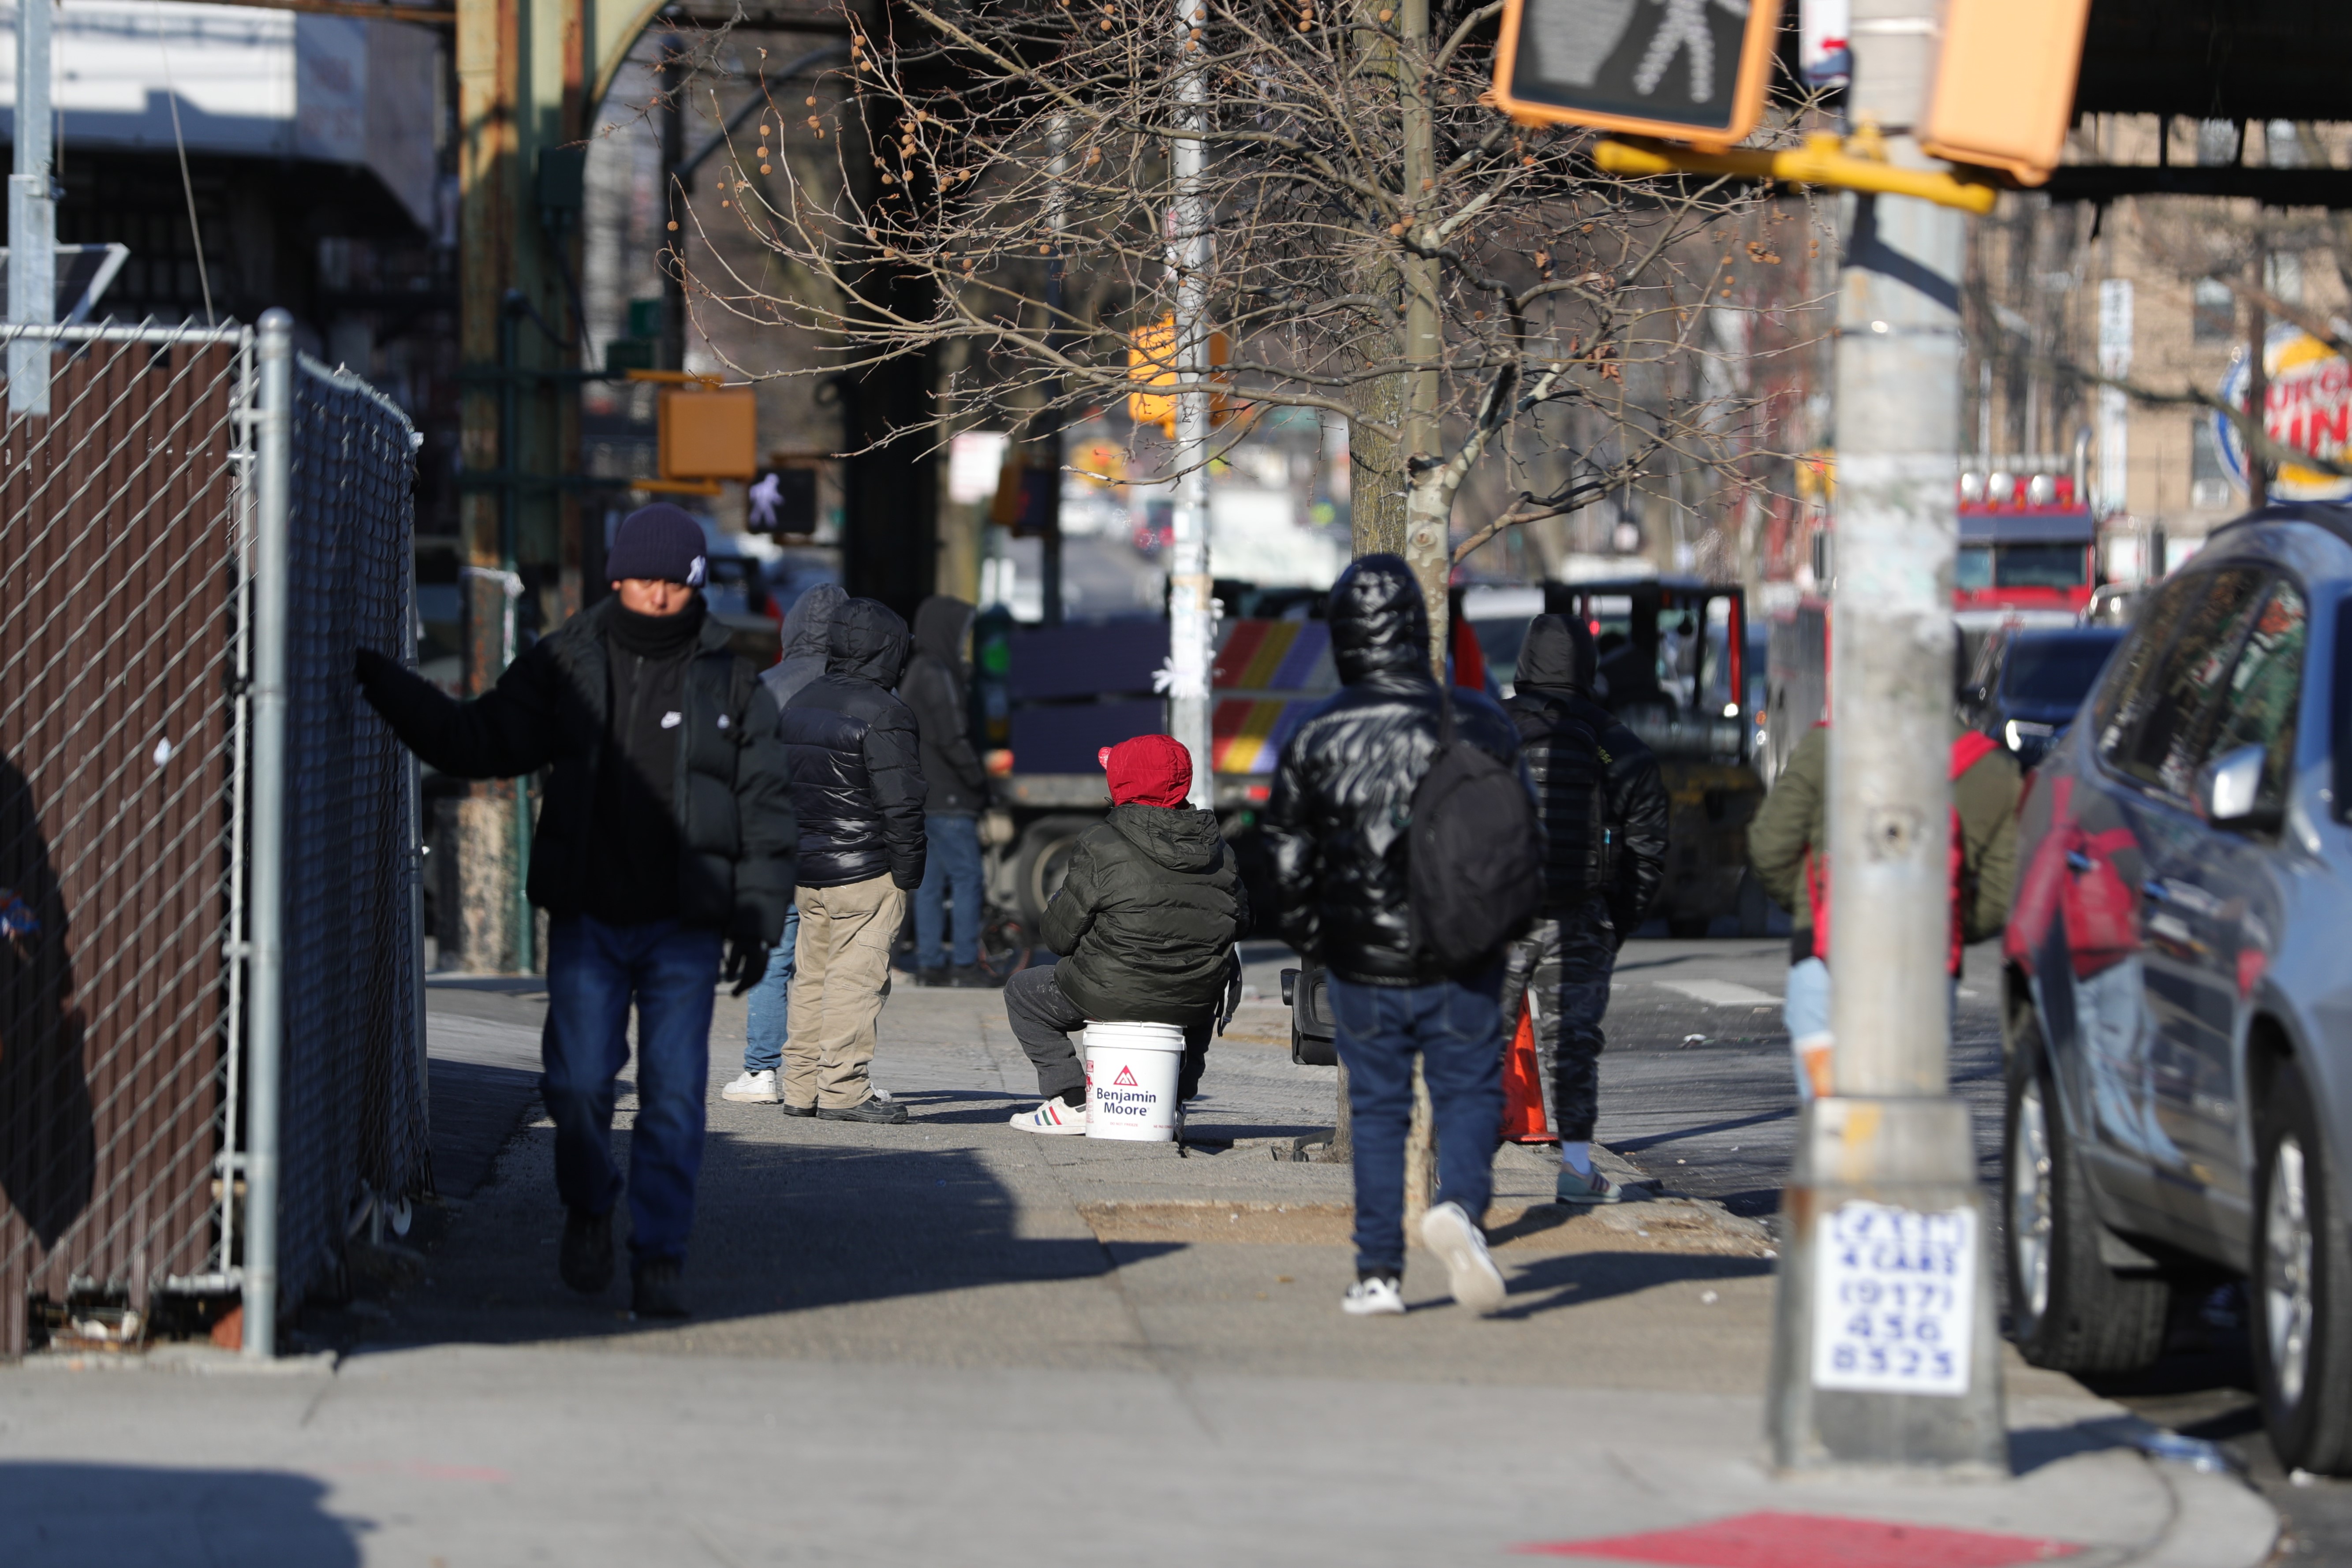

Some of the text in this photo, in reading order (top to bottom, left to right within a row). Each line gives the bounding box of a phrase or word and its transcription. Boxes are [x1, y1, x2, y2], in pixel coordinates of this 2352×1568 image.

[1097, 1087, 1156, 1103] Benjamin
[1104, 1102, 1147, 1116] Moore
[1870, 1241, 1958, 1276] CARS
[1839, 1278, 1955, 1310] (917)
